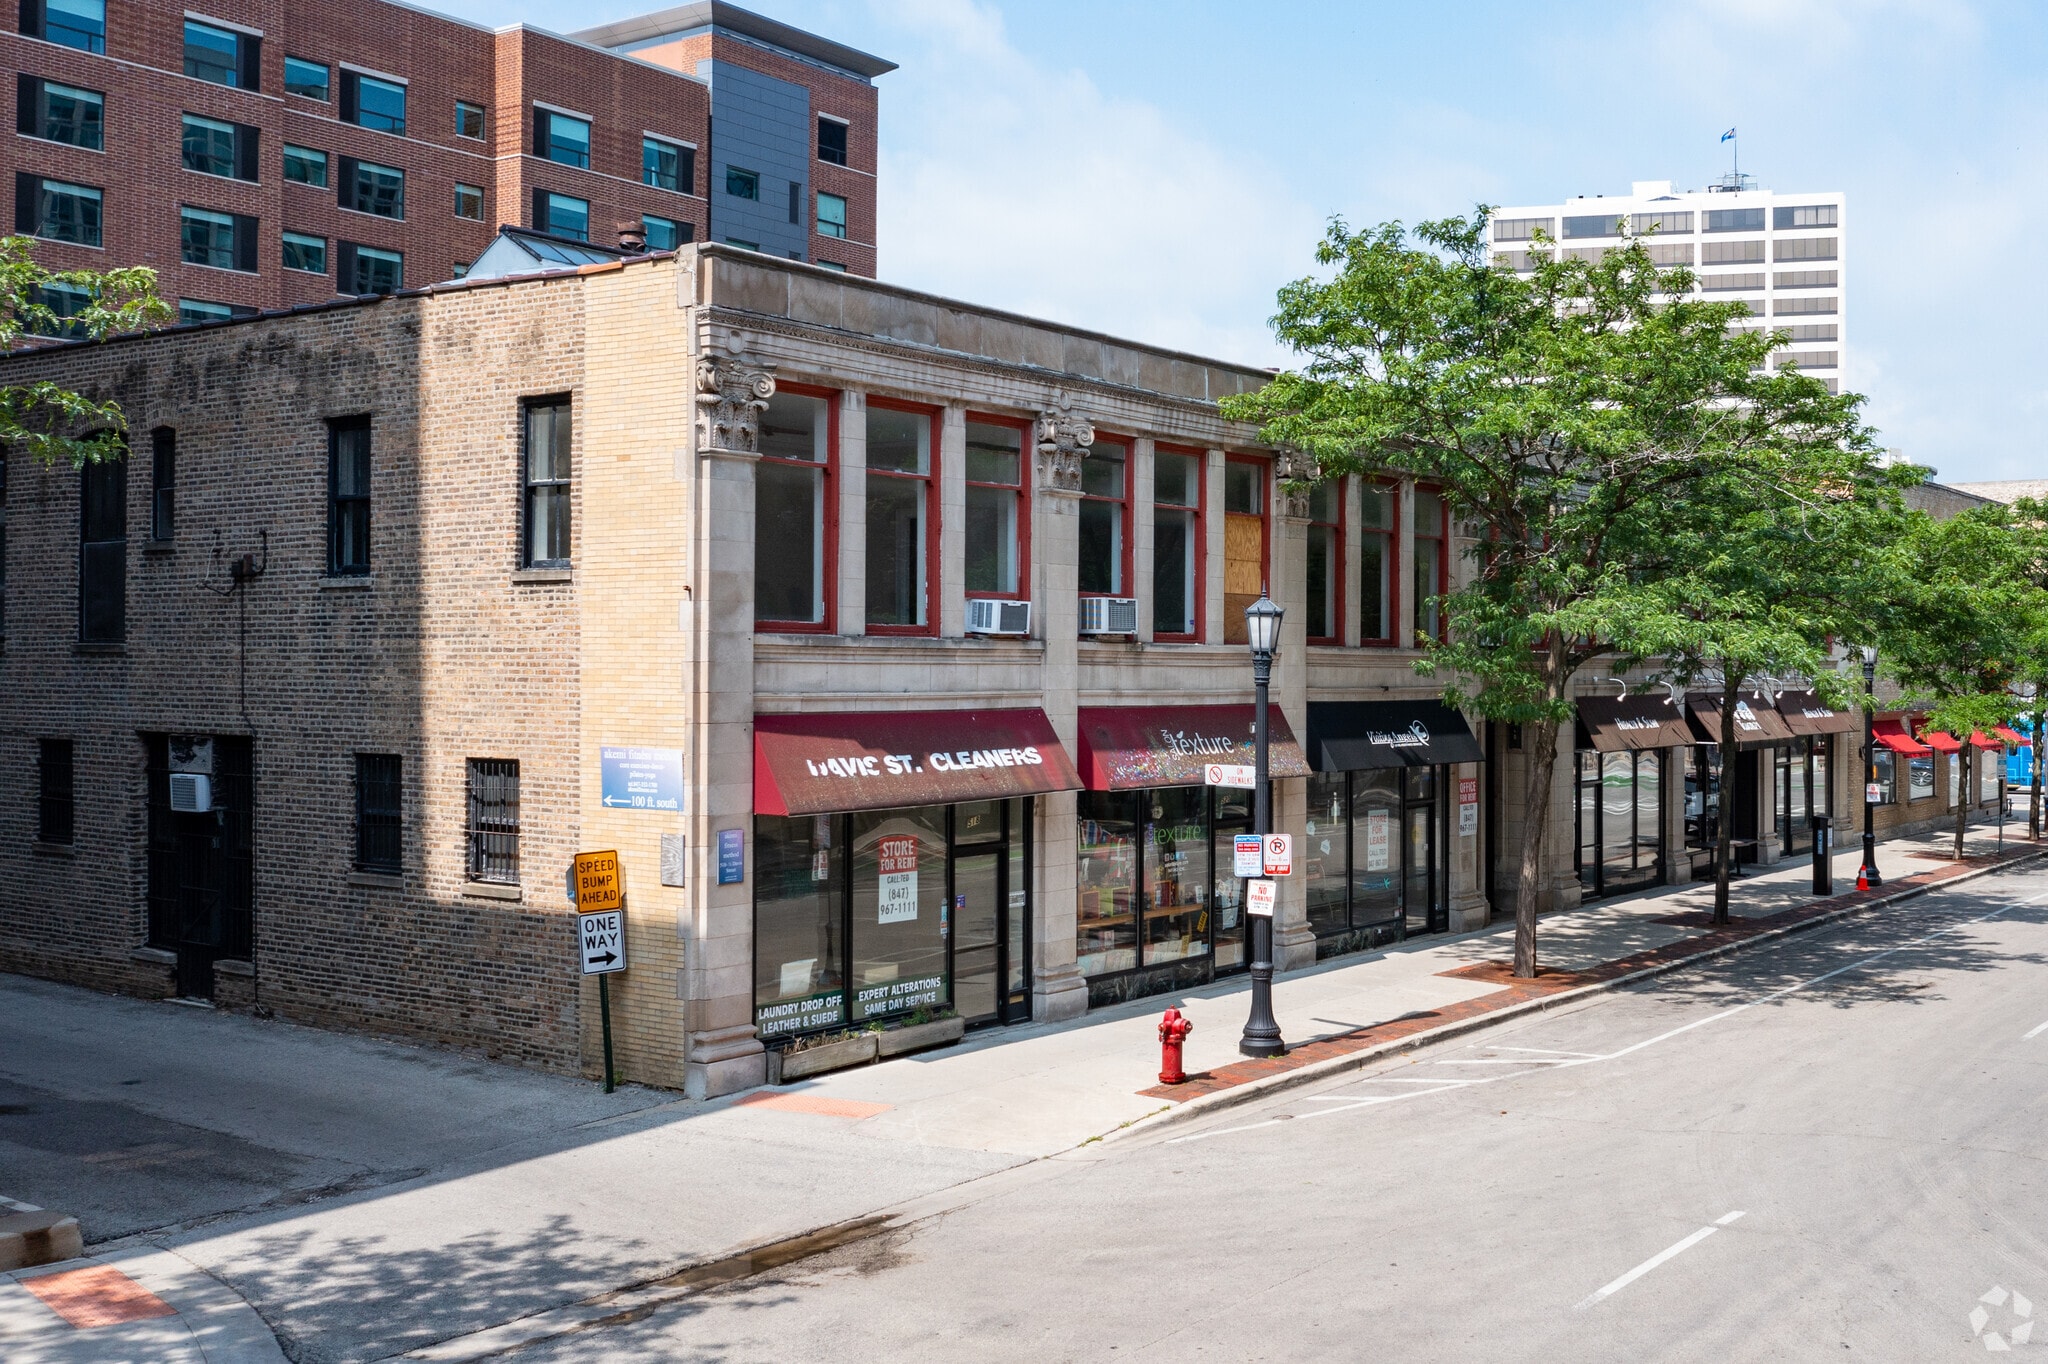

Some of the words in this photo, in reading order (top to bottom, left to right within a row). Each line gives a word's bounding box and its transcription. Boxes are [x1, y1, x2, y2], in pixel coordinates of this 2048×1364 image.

[1169, 732, 1235, 756] texture
[604, 748, 627, 759] akemi
[883, 753, 923, 774] ST.
[929, 747, 1043, 771] CLEANERS
[1227, 776, 1253, 784] SIDEWALKS
[1460, 781, 1476, 793] OFFICE
[631, 796, 646, 807] 100
[647, 796, 655, 807] ft.
[656, 797, 678, 808] south
[1369, 814, 1387, 823] STORE
[1153, 825, 1201, 845] texture
[1372, 825, 1383, 834] FOR
[1369, 836, 1387, 845] LEASE
[882, 840, 914, 858] STORE
[579, 859, 614, 873] SPEED
[880, 859, 895, 871] FOR
[897, 857, 916, 870] RENT
[582, 875, 613, 889] BUMP
[581, 889, 617, 904] AHEAD
[888, 887, 909, 901] (847)
[1258, 887, 1267, 895] NO
[1251, 895, 1273, 903] PARKING
[880, 901, 916, 915] 967-1111
[585, 916, 617, 933] ONE
[585, 932, 618, 950] WAY
[858, 987, 889, 1002] EXPERT
[891, 976, 941, 996] ALTERATIONS
[758, 1002, 799, 1020] LAUNDRY
[800, 998, 824, 1012] DROP
[825, 995, 842, 1008] OFF
[864, 1001, 887, 1015] SAME
[888, 998, 904, 1010] DAY
[905, 992, 936, 1007] SERVICE
[762, 1015, 800, 1034] LEATHER
[802, 1015, 809, 1026] &
[811, 1011, 838, 1025] SUEDE
